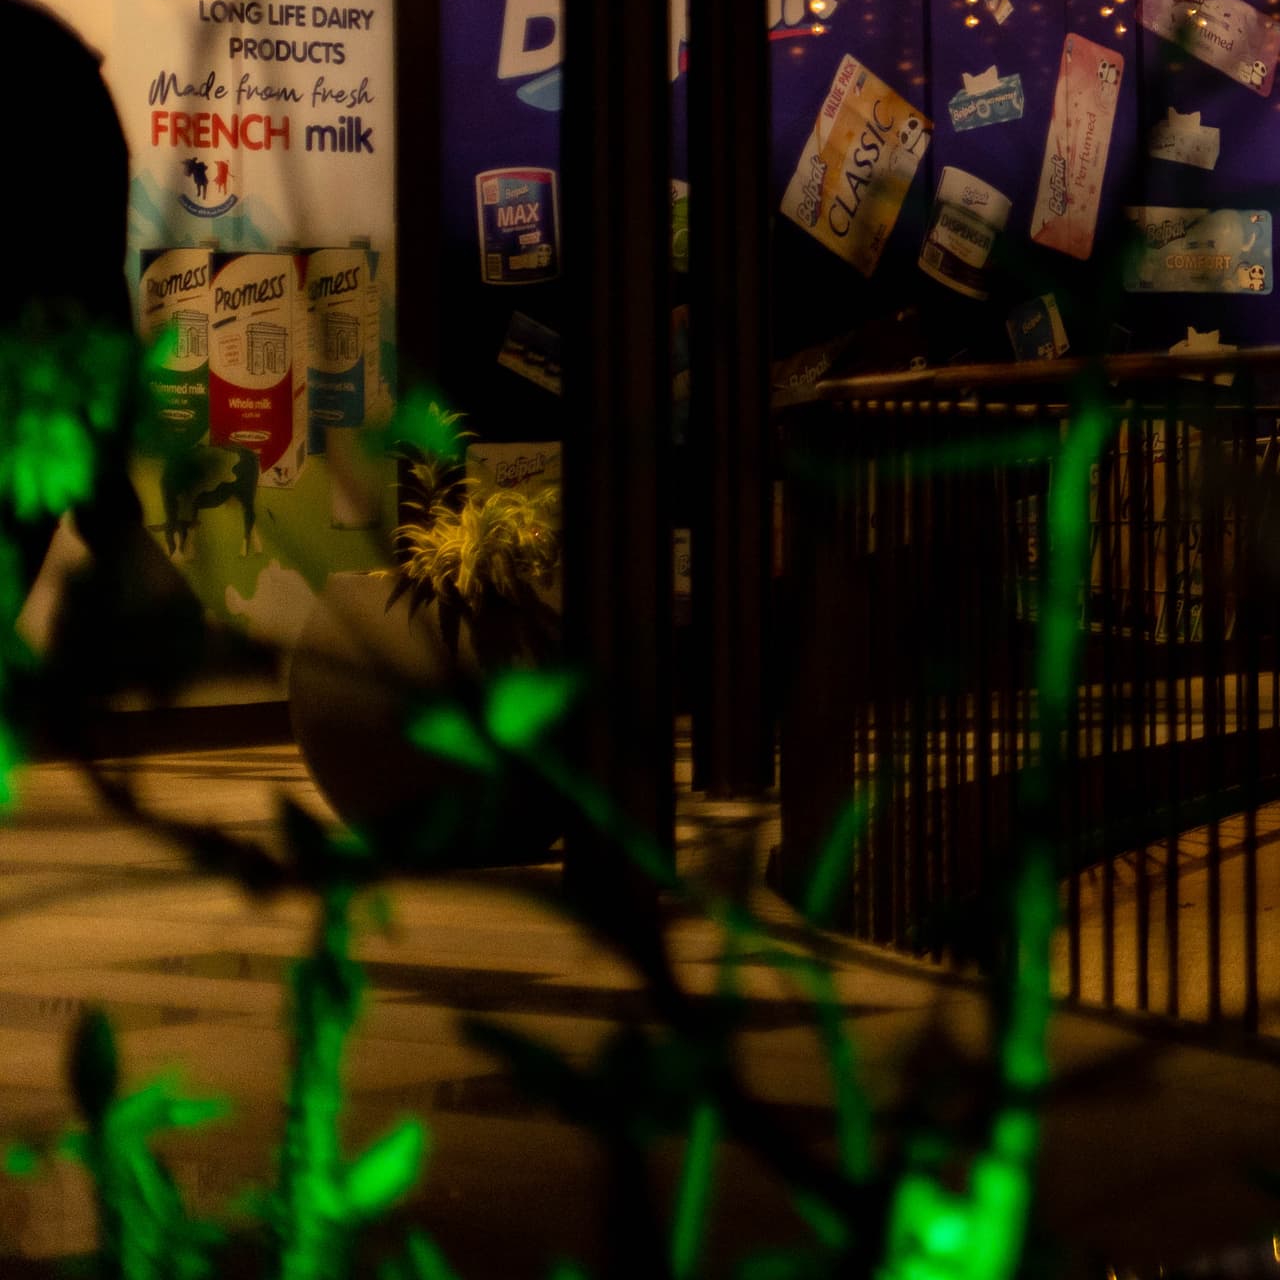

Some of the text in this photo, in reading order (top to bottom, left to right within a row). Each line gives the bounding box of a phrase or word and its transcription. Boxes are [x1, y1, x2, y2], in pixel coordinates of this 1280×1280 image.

[199, 0, 374, 30] LONG LIFE DAIRY
[229, 37, 346, 64] PRODUCTS
[149, 70, 375, 108] Made from fresh
[151, 111, 374, 153] FRENCH milk
[1074, 112, 1097, 188] Perfumed
[828, 99, 895, 238] CLASSIC
[497, 201, 540, 228] MAX
